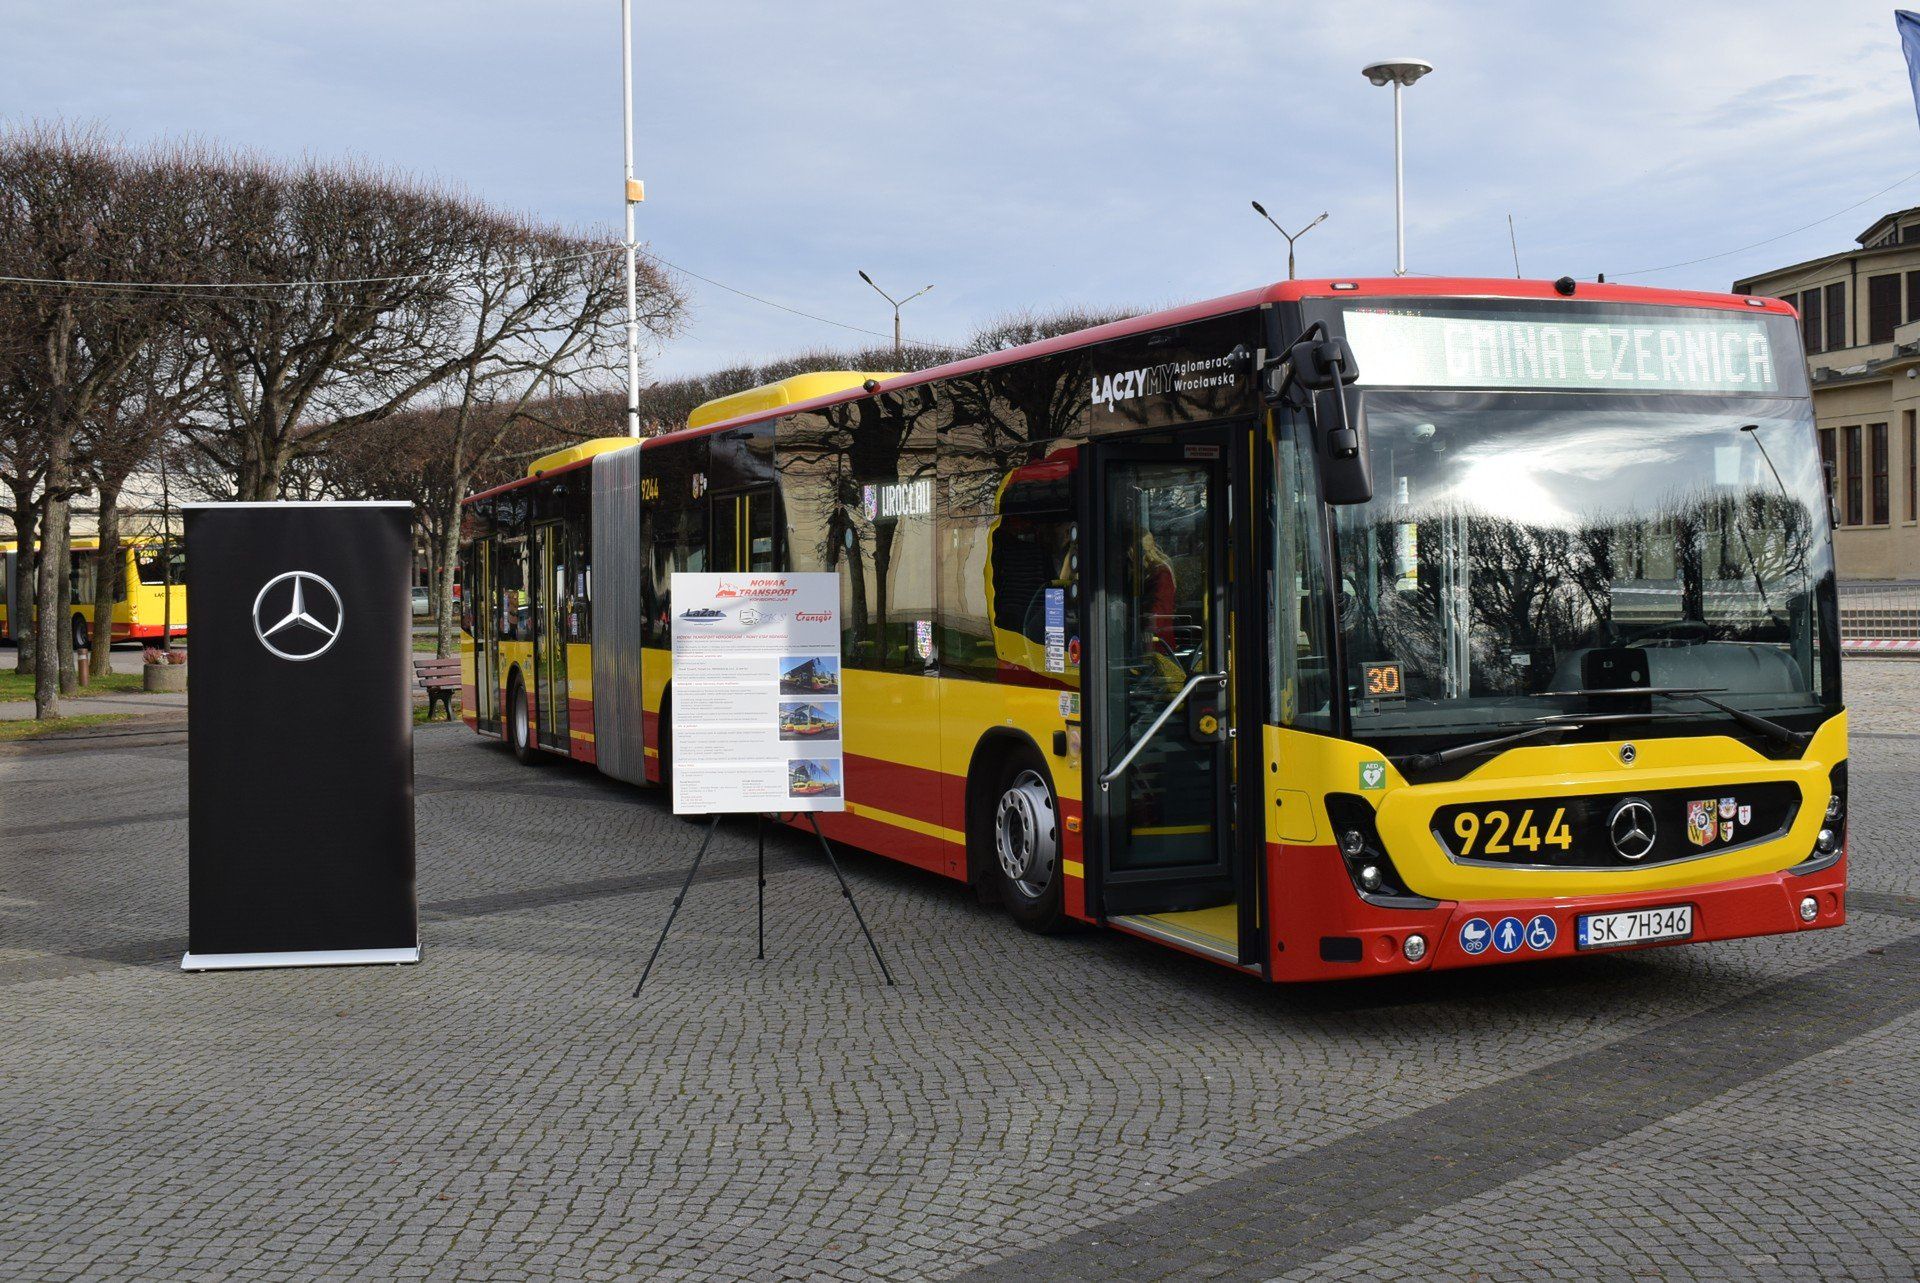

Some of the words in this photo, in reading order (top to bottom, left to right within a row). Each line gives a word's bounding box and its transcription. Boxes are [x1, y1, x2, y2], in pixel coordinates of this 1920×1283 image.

[1445, 322, 1567, 380] GMINA
[1580, 326, 1772, 384] CZERNICA
[1174, 357, 1232, 376] Aglomerac
[1174, 372, 1235, 392] Wrocławską
[641, 477, 659, 500] 9244
[882, 481, 931, 517] WROCŁAW
[750, 579, 787, 587] NOWAK
[686, 608, 721, 617] LaZar
[1368, 667, 1399, 694] 30
[1453, 807, 1573, 856] 9244
[1593, 916, 1618, 941] SK
[1627, 909, 1687, 939] 7H346
